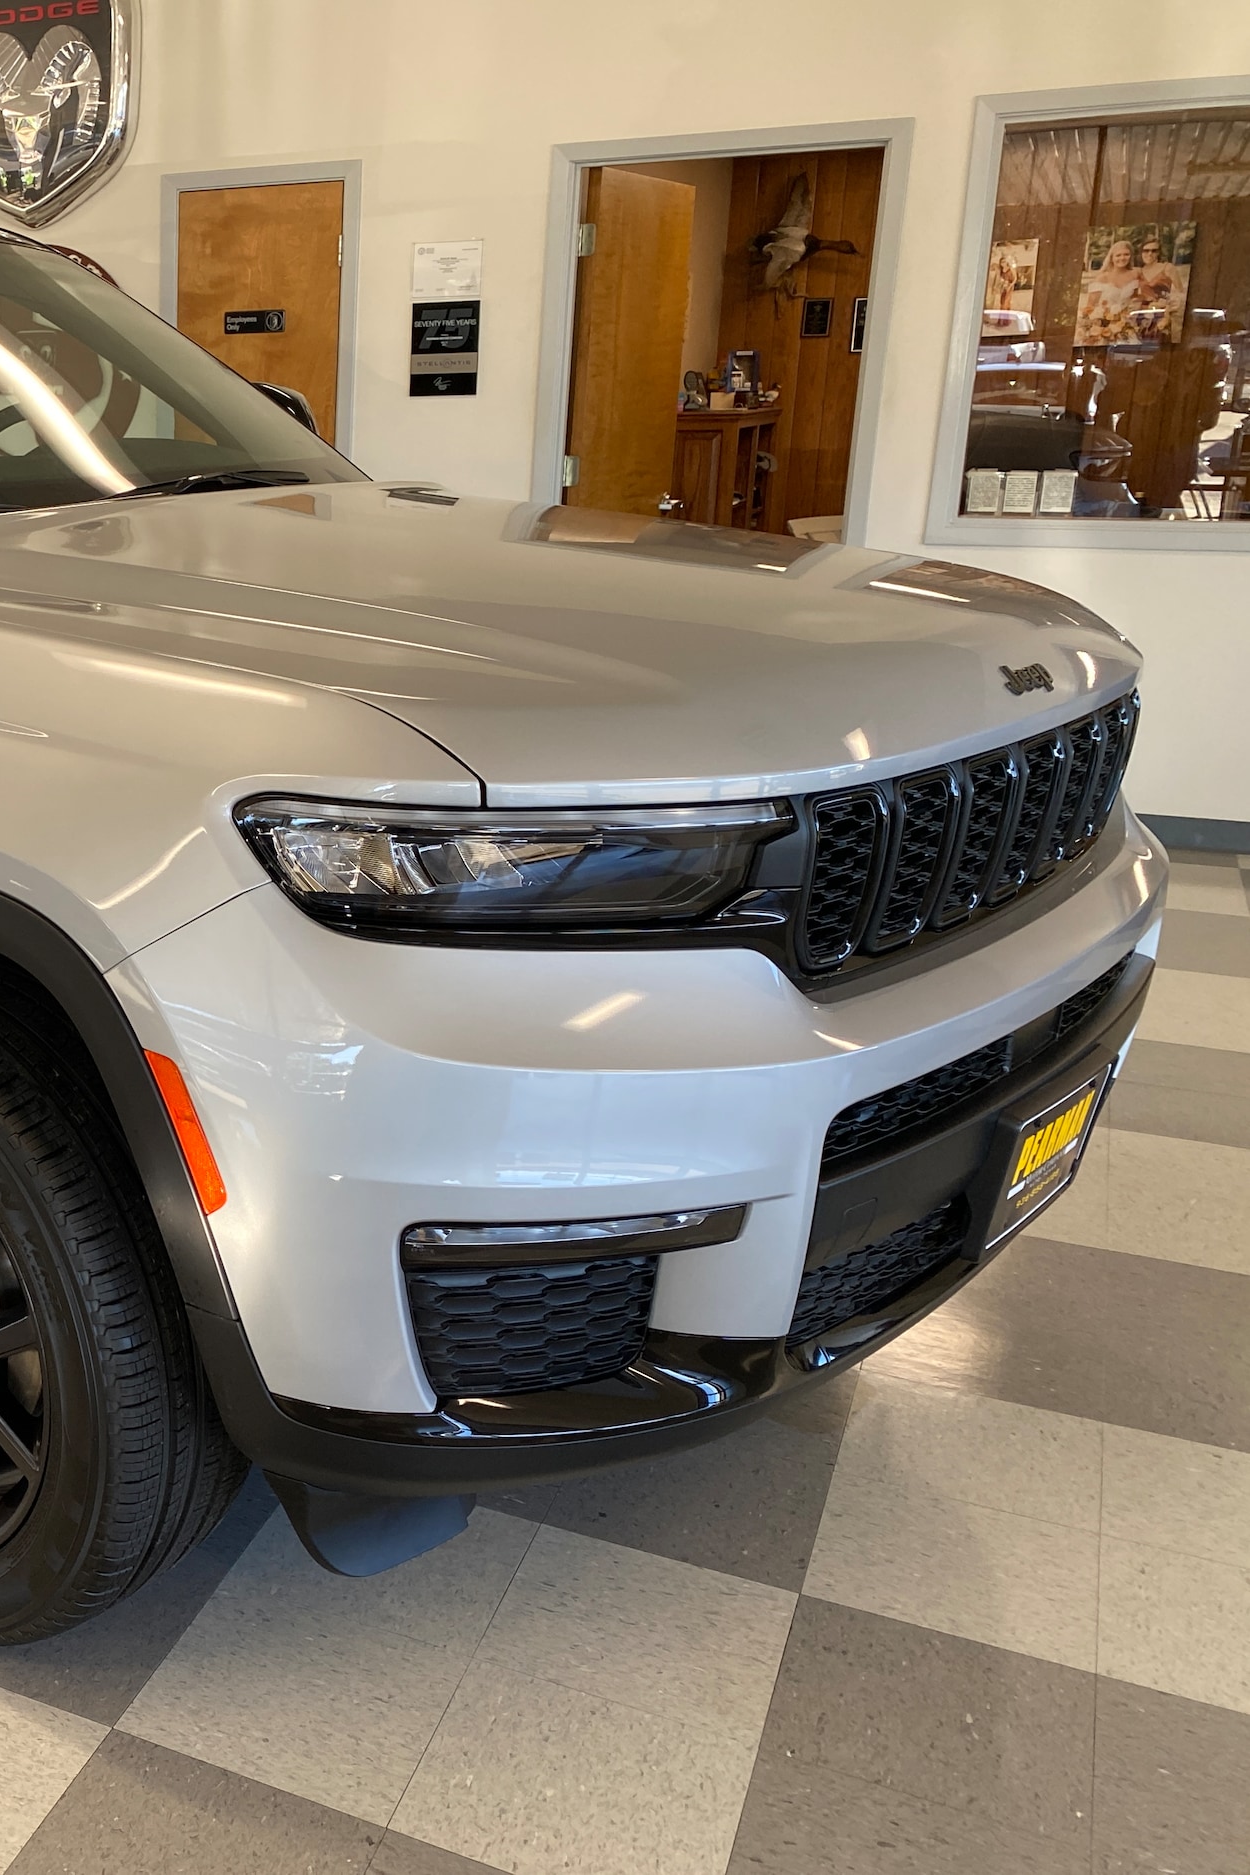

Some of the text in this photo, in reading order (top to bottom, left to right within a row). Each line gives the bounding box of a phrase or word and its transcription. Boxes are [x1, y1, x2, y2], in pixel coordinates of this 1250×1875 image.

[226, 315, 257, 324] Employees
[414, 318, 477, 328] SEVENTY FIVE YEARS
[226, 324, 240, 332] Only
[419, 308, 473, 349] 75
[417, 359, 471, 368] STELLANTIS
[999, 663, 1054, 696] Jeep
[1011, 1089, 1096, 1186] PEARMAN
